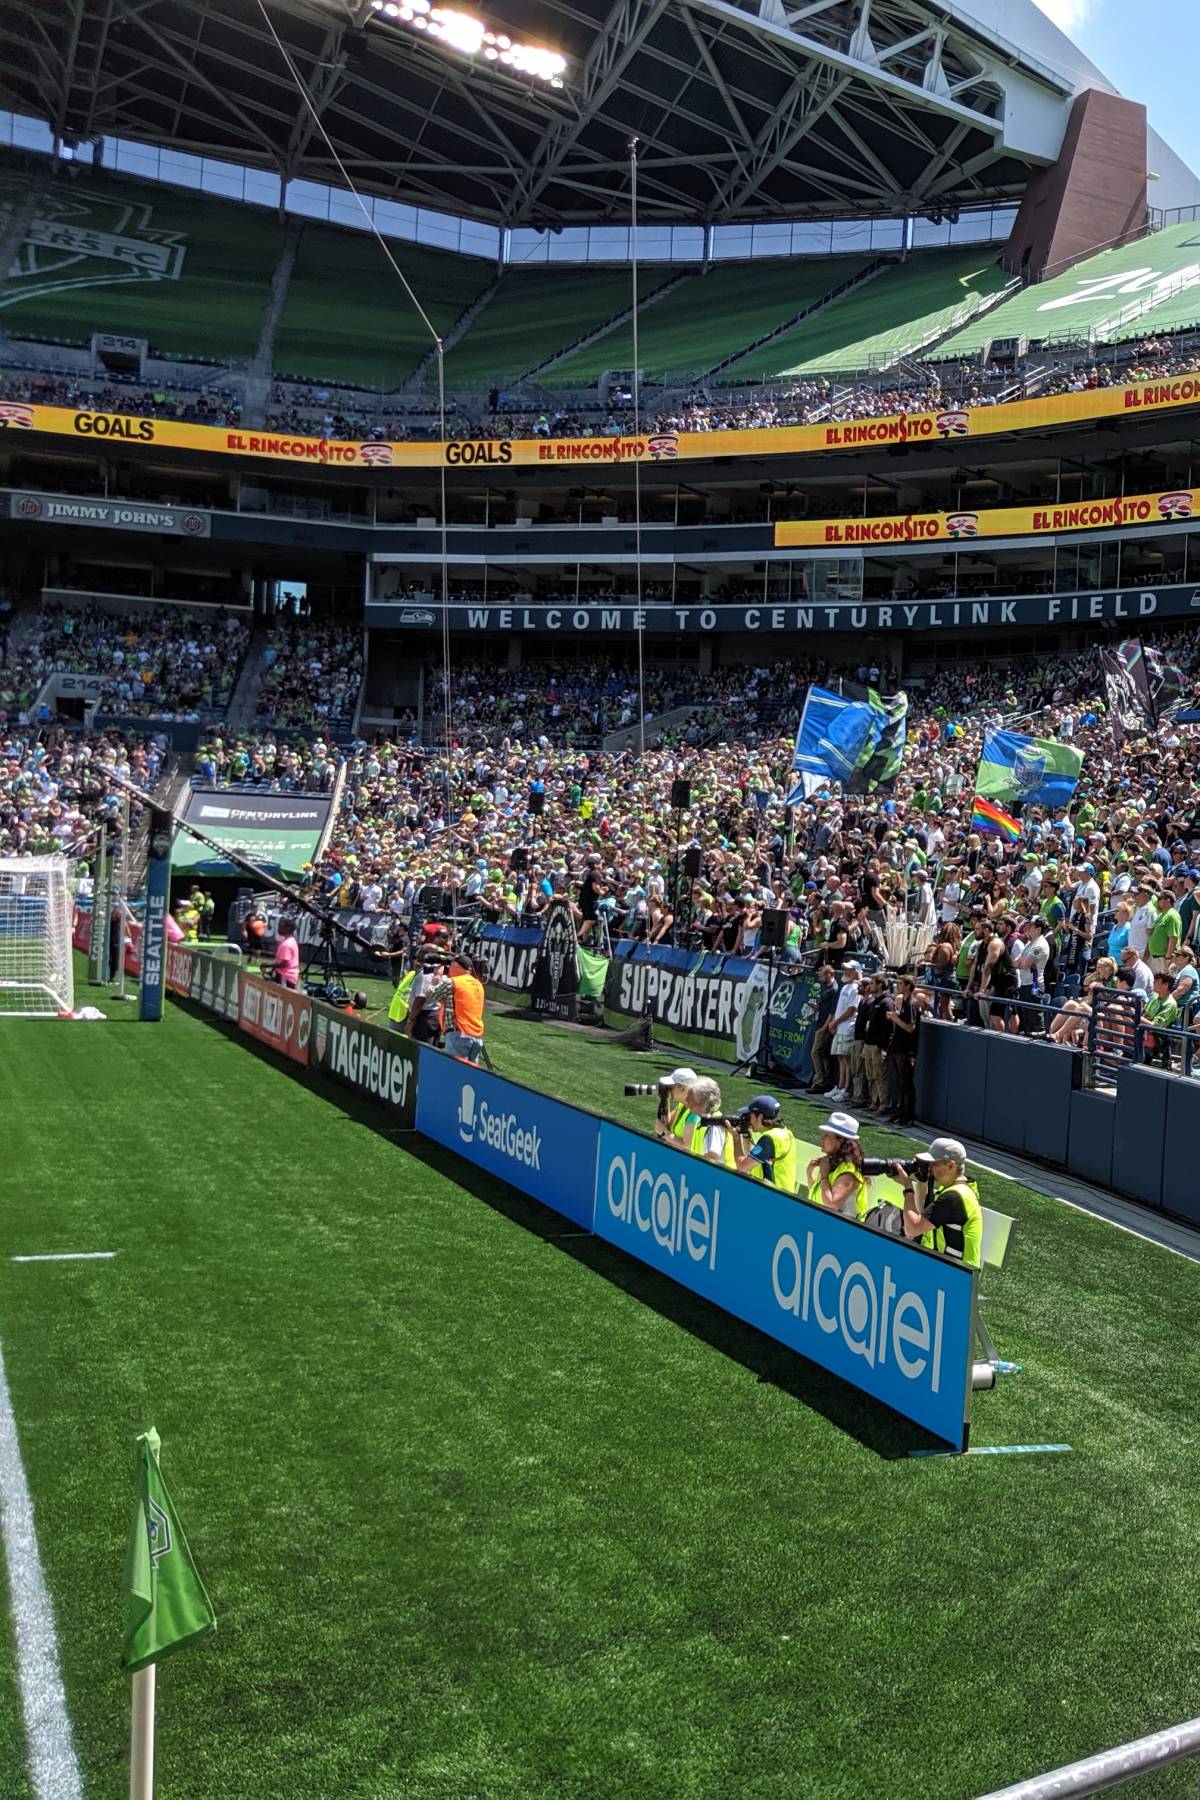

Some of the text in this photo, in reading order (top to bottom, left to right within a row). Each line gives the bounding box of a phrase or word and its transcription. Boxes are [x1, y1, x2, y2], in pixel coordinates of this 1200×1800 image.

[113, 246, 161, 266] FC
[103, 336, 137, 349] 314
[1124, 390, 1143, 408] EL
[75, 413, 154, 441] GOALS
[826, 412, 932, 445] EL RINCONSITO
[227, 434, 357, 464] EL RINCONSITO
[446, 442, 512, 464] GOALS
[539, 437, 645, 463] EL RINCONSITO
[47, 502, 174, 528] JIMMY JOHN'S
[1033, 498, 1151, 530] EL RINCONSITO
[825, 515, 939, 542] EL RINCONSITO
[468, 593, 1157, 631] WELCOME TO CENTURYLINK FIELD
[62, 678, 100, 690] 214
[145, 895, 165, 985] SEATTLE
[478, 1101, 541, 1170] SeatGeek
[608, 1152, 720, 1270] alcatel
[772, 1231, 945, 1393] alcatel
